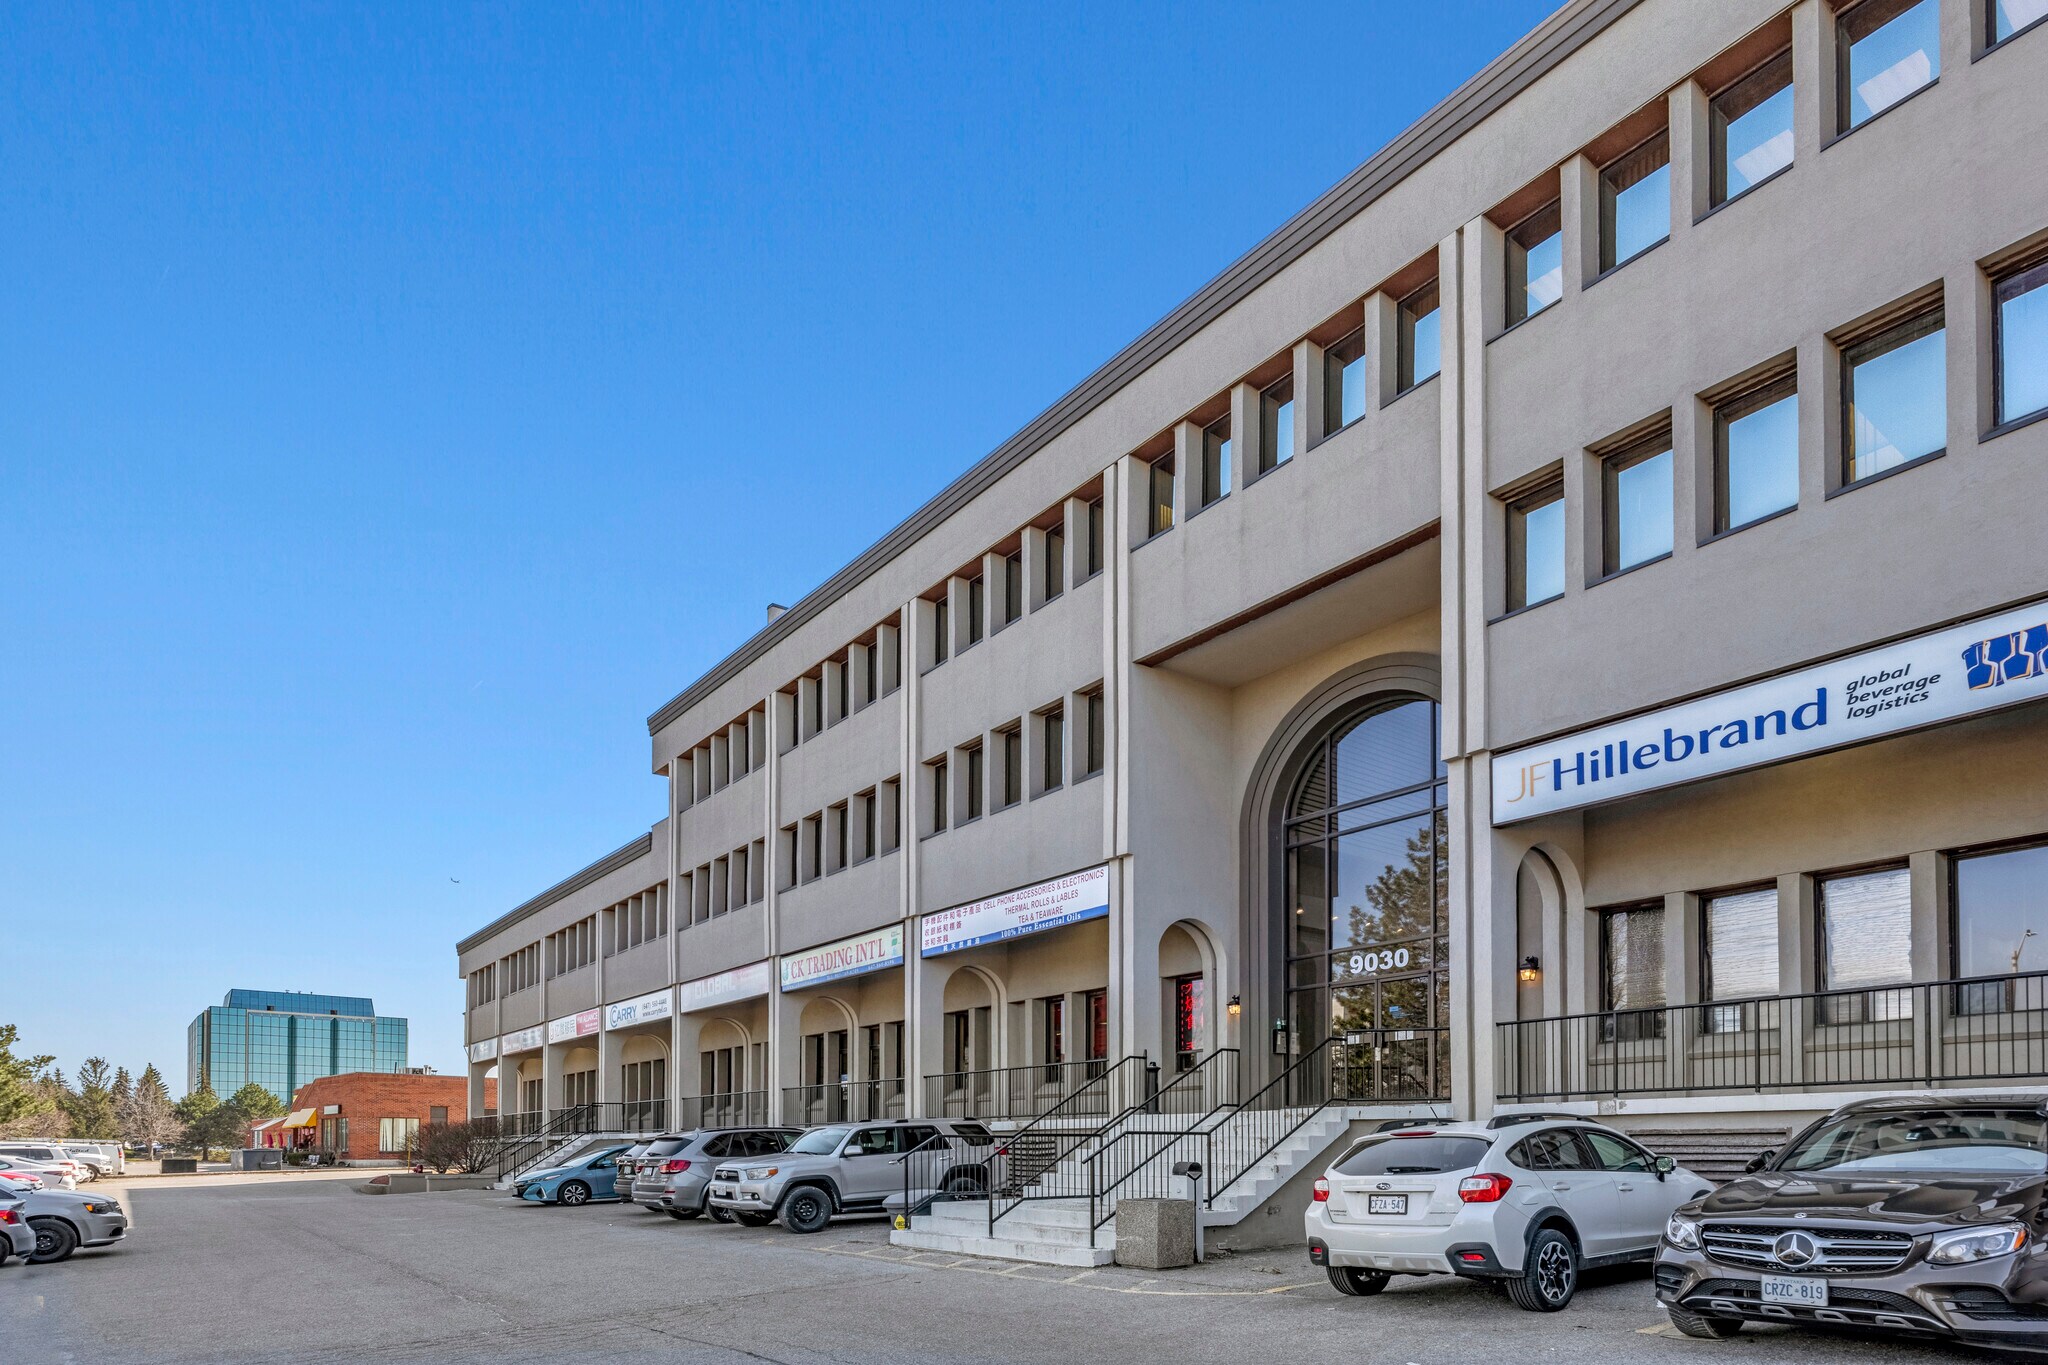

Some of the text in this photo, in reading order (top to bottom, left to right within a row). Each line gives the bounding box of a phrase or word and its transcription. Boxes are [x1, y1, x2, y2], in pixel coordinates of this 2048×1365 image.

[1846, 663, 1911, 694] global
[1846, 673, 1941, 705] beverage
[1846, 690, 1929, 719] logistics
[983, 901, 996, 910] CELL
[996, 895, 1015, 906] PHONE
[1015, 883, 1056, 903] ACCESSORIES
[1062, 869, 1104, 888] ELECTRONICS
[1004, 902, 1030, 916] THERMAL
[1030, 897, 1050, 909] ROLLS
[1056, 889, 1079, 902] LABLES
[1000, 912, 1081, 938] 100% Pure Essential Oils
[1018, 914, 1029, 924] TEA
[1035, 905, 1064, 919] TEAWARE
[791, 959, 804, 979] CK
[805, 946, 853, 975] TRADING
[1349, 948, 1409, 974] 9030
[610, 1005, 637, 1028] CARRY
